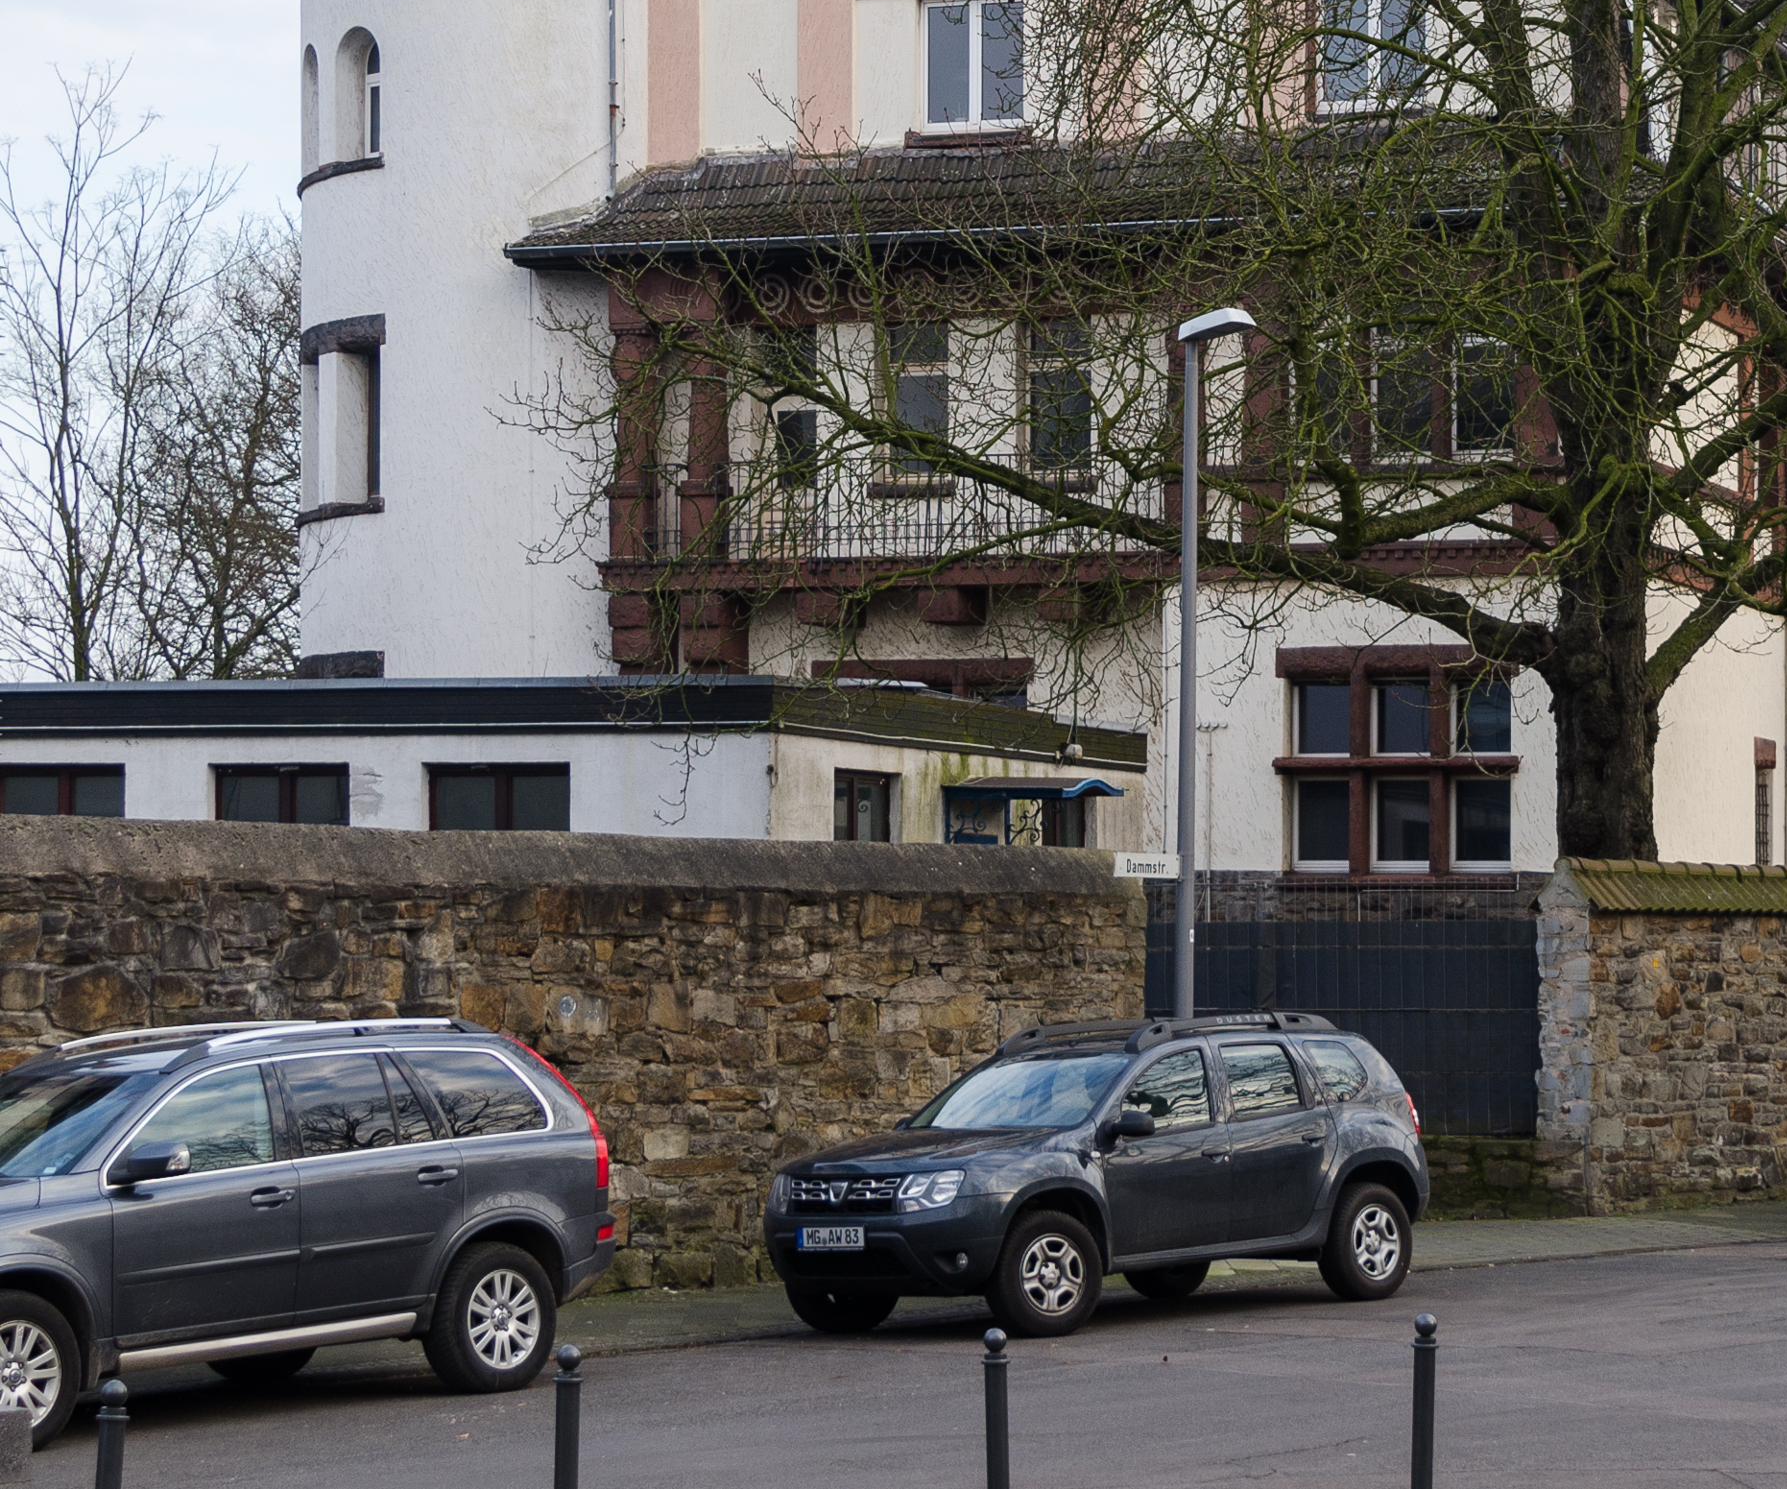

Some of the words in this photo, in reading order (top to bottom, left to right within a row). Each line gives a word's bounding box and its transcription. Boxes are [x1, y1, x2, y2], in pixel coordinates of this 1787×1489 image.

[1126, 858, 1169, 874] Dammstr.
[1216, 1014, 1271, 1024] DUSTER
[806, 1229, 821, 1245] MG
[828, 1229, 842, 1244] AW
[845, 1228, 859, 1244] 83
